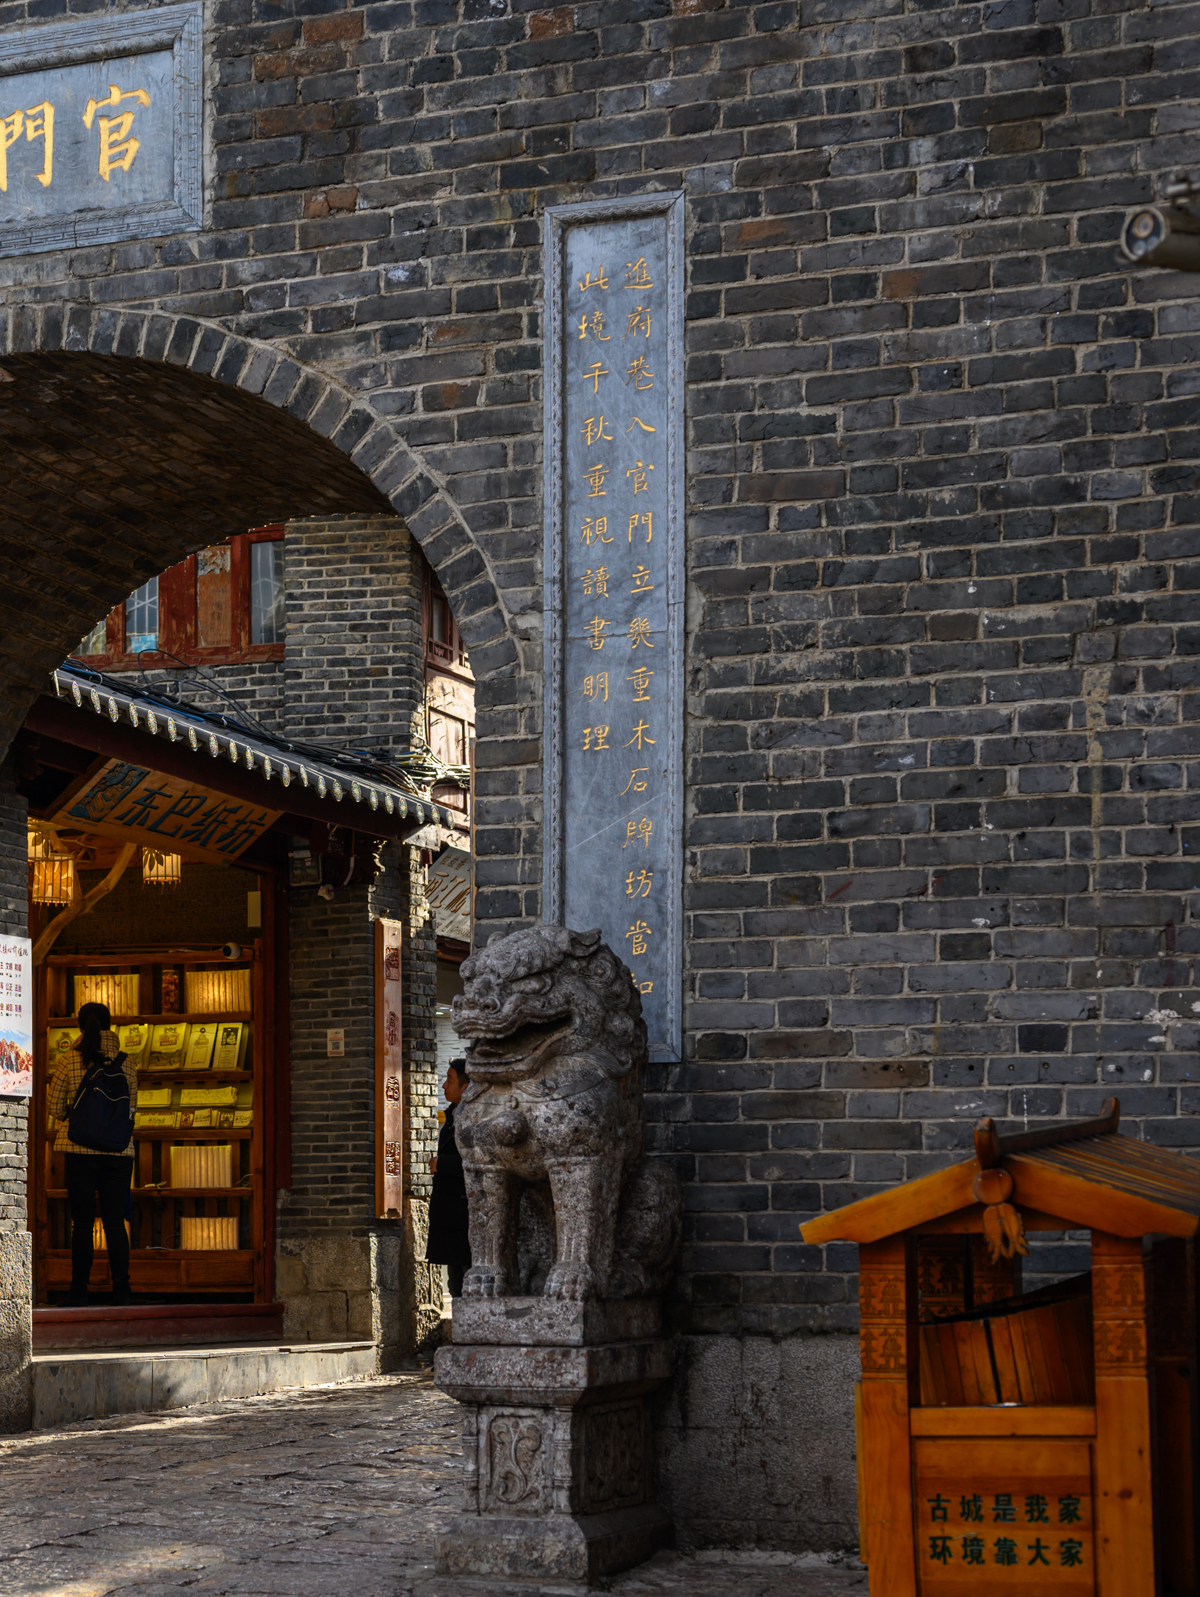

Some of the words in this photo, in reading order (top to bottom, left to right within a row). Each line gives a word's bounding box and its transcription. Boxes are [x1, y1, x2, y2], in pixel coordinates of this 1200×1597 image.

[578, 265, 613, 751] 此境千秋重視讀書明理
[927, 1493, 1083, 1523] 古城是我家
[928, 1535, 1083, 1567] 环境靠大家
